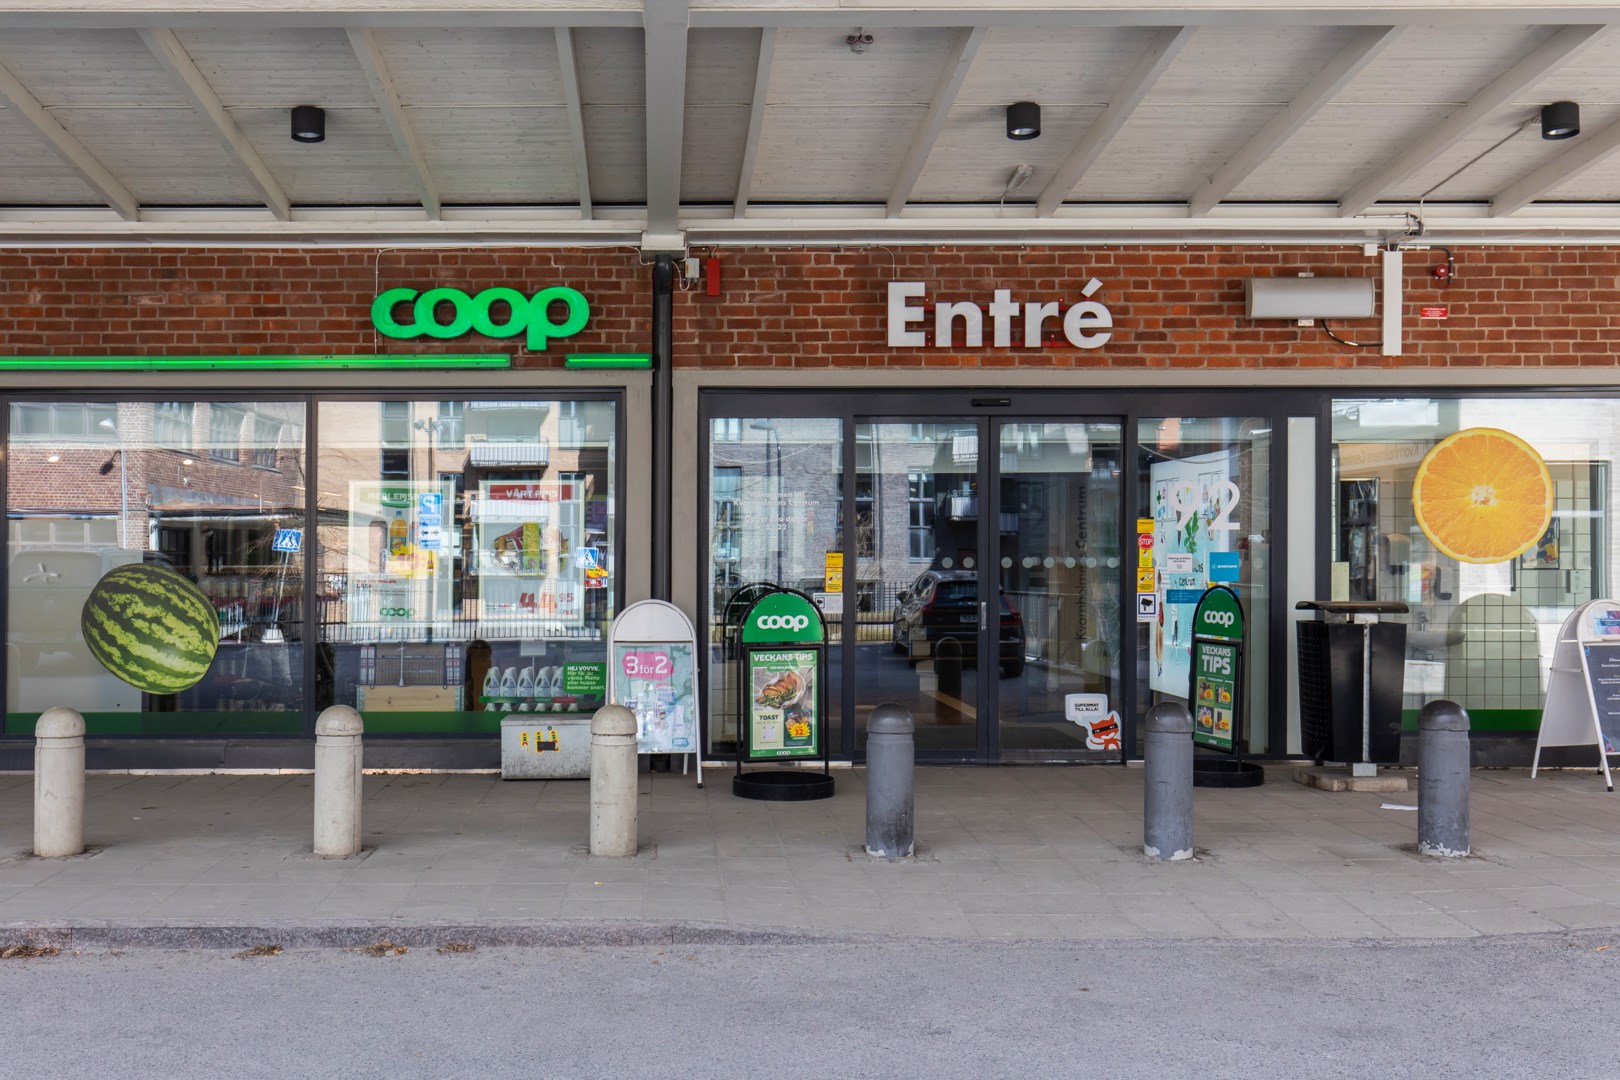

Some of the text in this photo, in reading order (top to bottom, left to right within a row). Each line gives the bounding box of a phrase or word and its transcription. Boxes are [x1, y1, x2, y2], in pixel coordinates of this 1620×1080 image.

[371, 286, 590, 350] coop
[887, 277, 1113, 349] Entré
[506, 488, 532, 498] VÅRT
[1171, 480, 1240, 530] 92
[1139, 538, 1153, 546] STOP
[1075, 486, 1087, 640] Kvarnholmes Centrum
[558, 592, 575, 603] 95
[379, 607, 417, 619] coop
[1203, 609, 1235, 628] coop
[756, 614, 810, 633] coop
[753, 653, 814, 662] VECKANS TIPS
[1202, 645, 1232, 657] VECKANS
[625, 655, 668, 675] 3 för 2
[1202, 654, 1231, 675] TIPS
